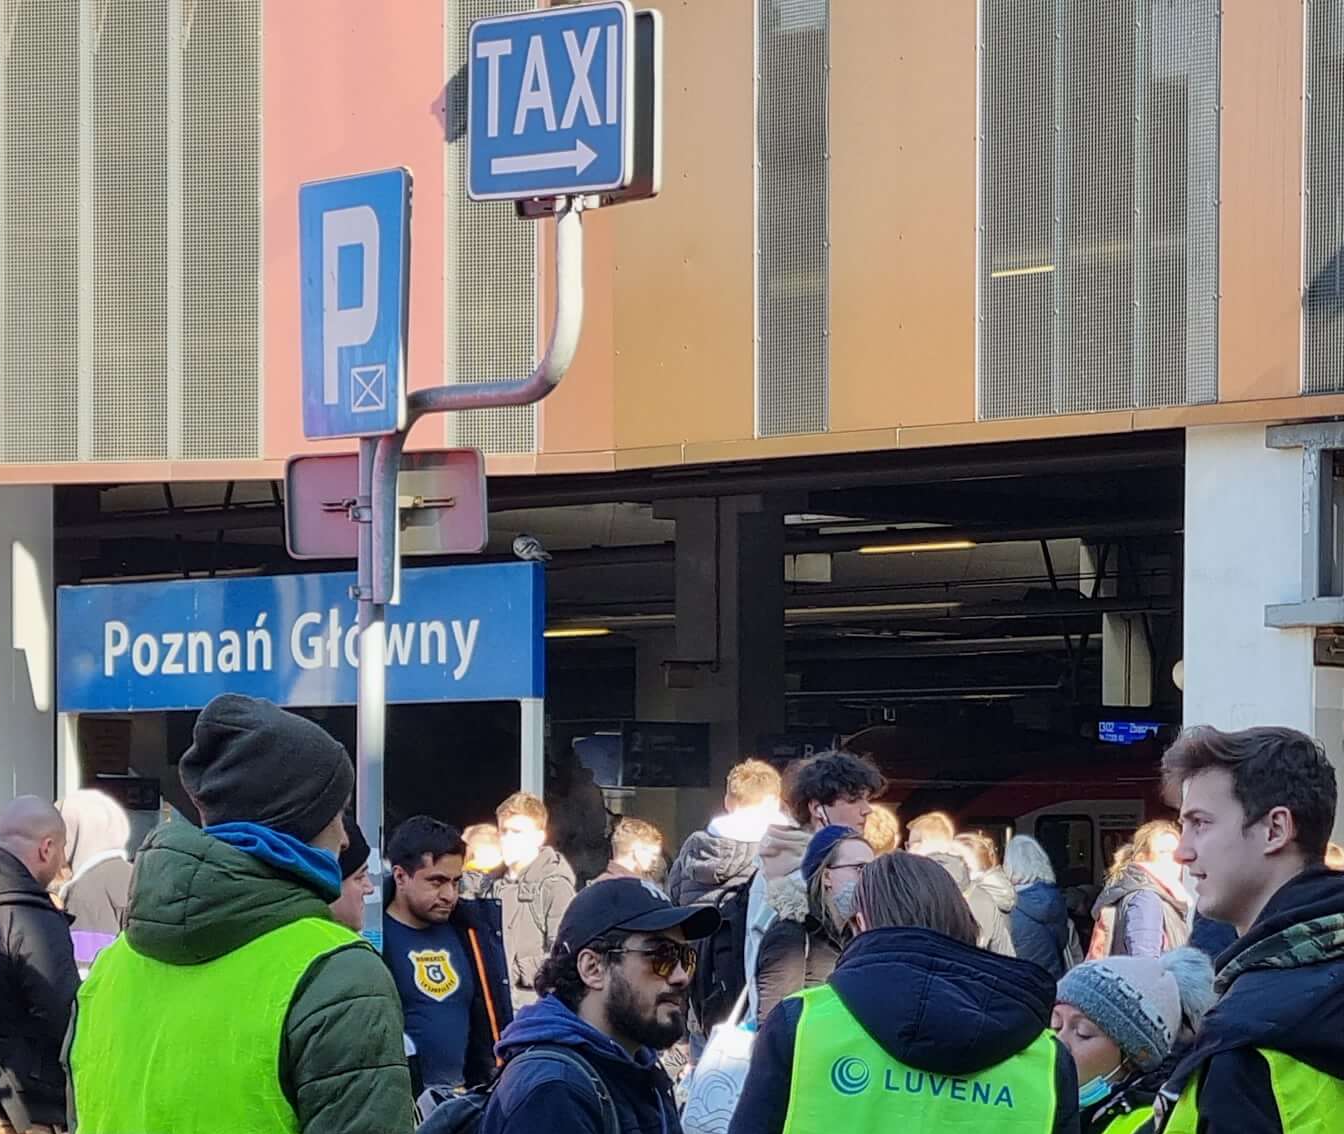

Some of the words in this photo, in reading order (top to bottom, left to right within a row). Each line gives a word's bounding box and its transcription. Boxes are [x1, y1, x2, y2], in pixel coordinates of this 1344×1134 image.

[476, 25, 617, 137] TAXI
[323, 206, 379, 404] P
[104, 612, 272, 677] Poznań
[885, 1068, 1014, 1108] LUVENA
